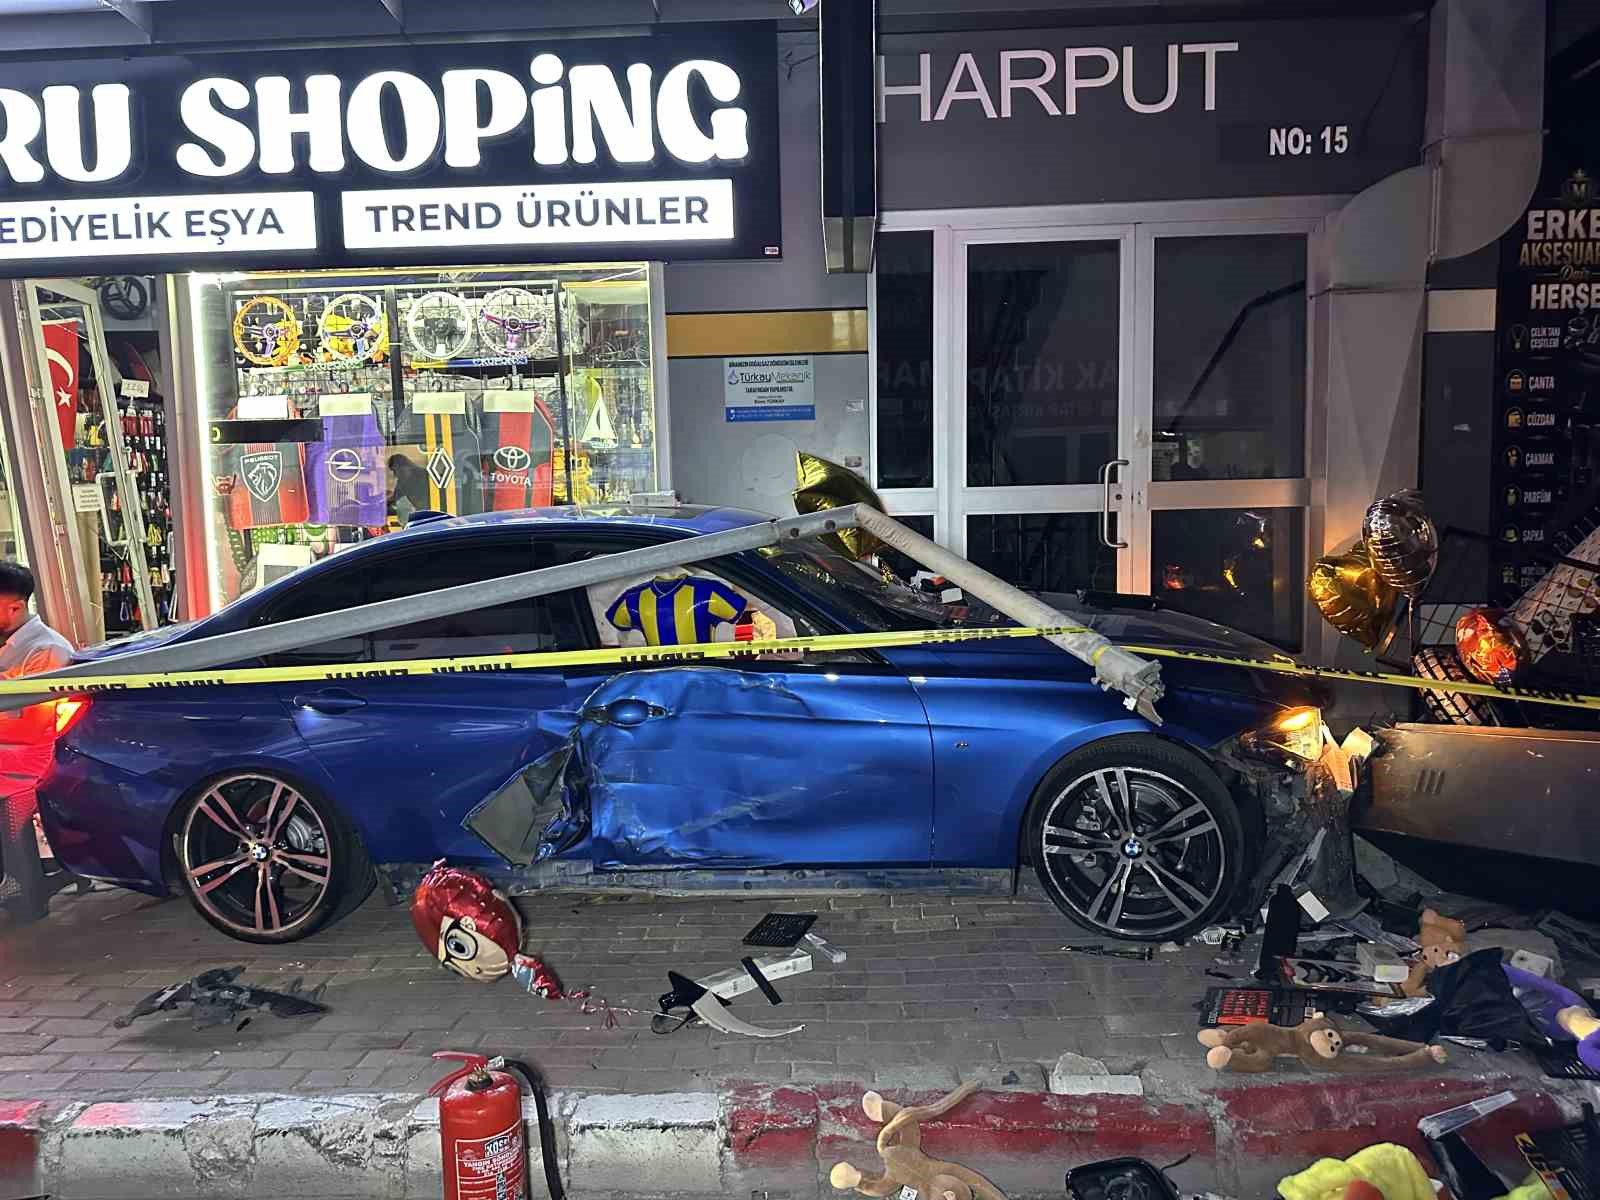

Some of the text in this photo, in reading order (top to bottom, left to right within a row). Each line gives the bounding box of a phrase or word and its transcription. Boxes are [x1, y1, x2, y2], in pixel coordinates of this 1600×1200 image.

[876, 42, 1239, 123] HARPUT
[0, 83, 131, 182] RU
[1269, 125, 1348, 156] NO: 15
[0, 203, 284, 245] EDİYELİK EŞYA
[365, 191, 709, 233] TREND ÜRÜNLER
[1529, 376, 1555, 391] ÇANTA
[490, 472, 531, 486] TOYOTA
